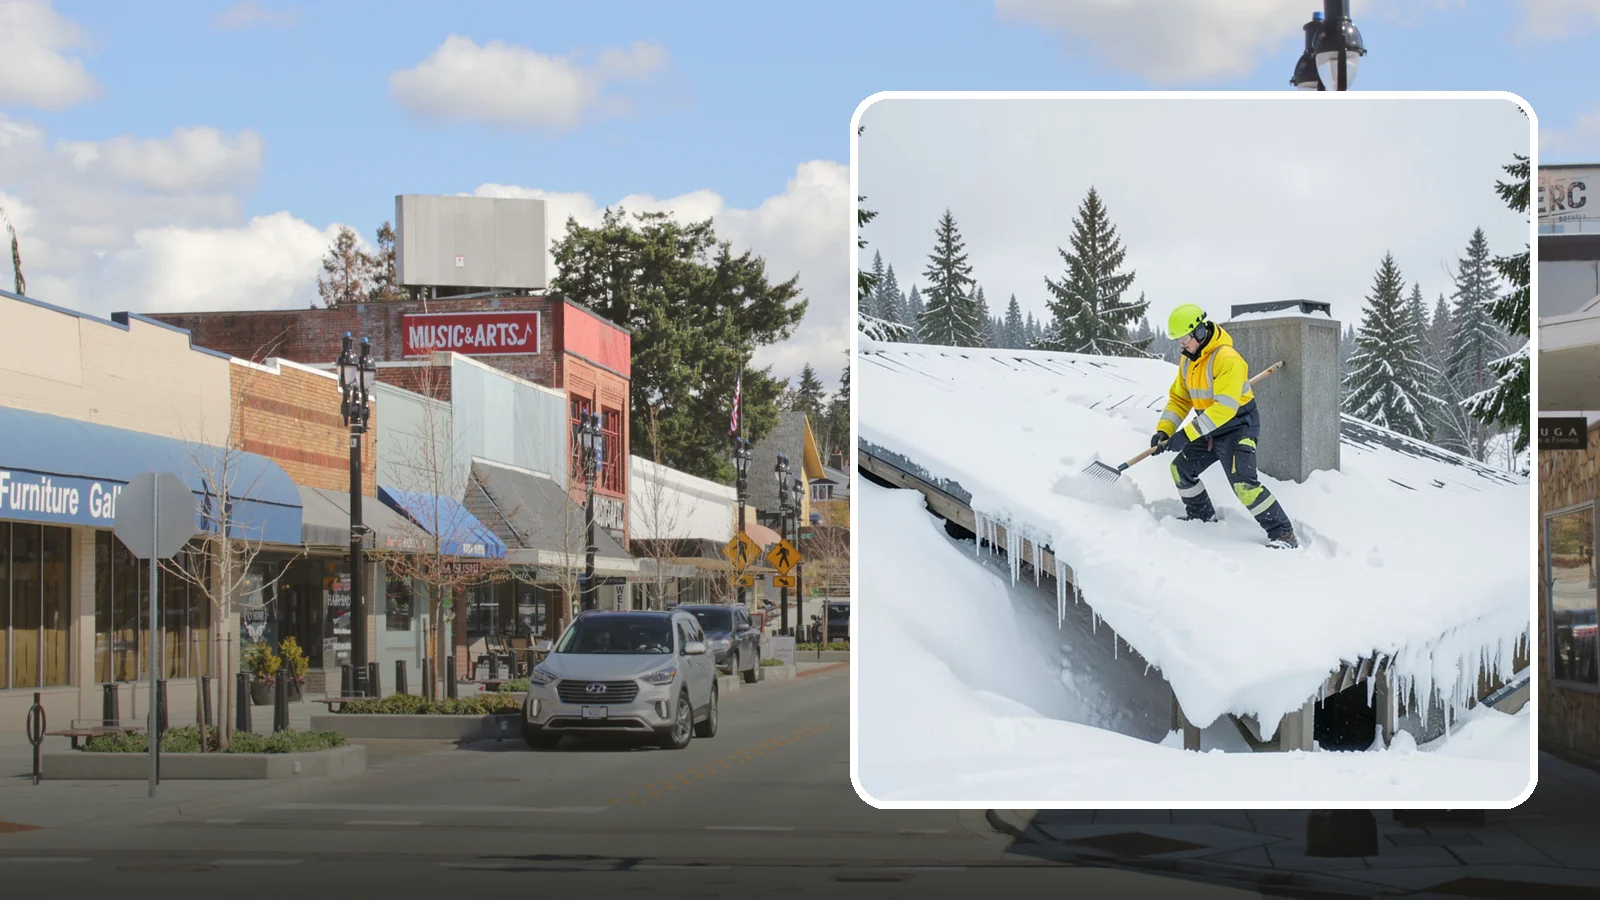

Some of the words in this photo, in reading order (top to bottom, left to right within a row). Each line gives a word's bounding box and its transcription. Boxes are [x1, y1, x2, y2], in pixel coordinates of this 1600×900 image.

[409, 322, 519, 349] MUSIC&ARTS
[0, 471, 79, 515] Furniture
[89, 482, 121, 519] Gal
